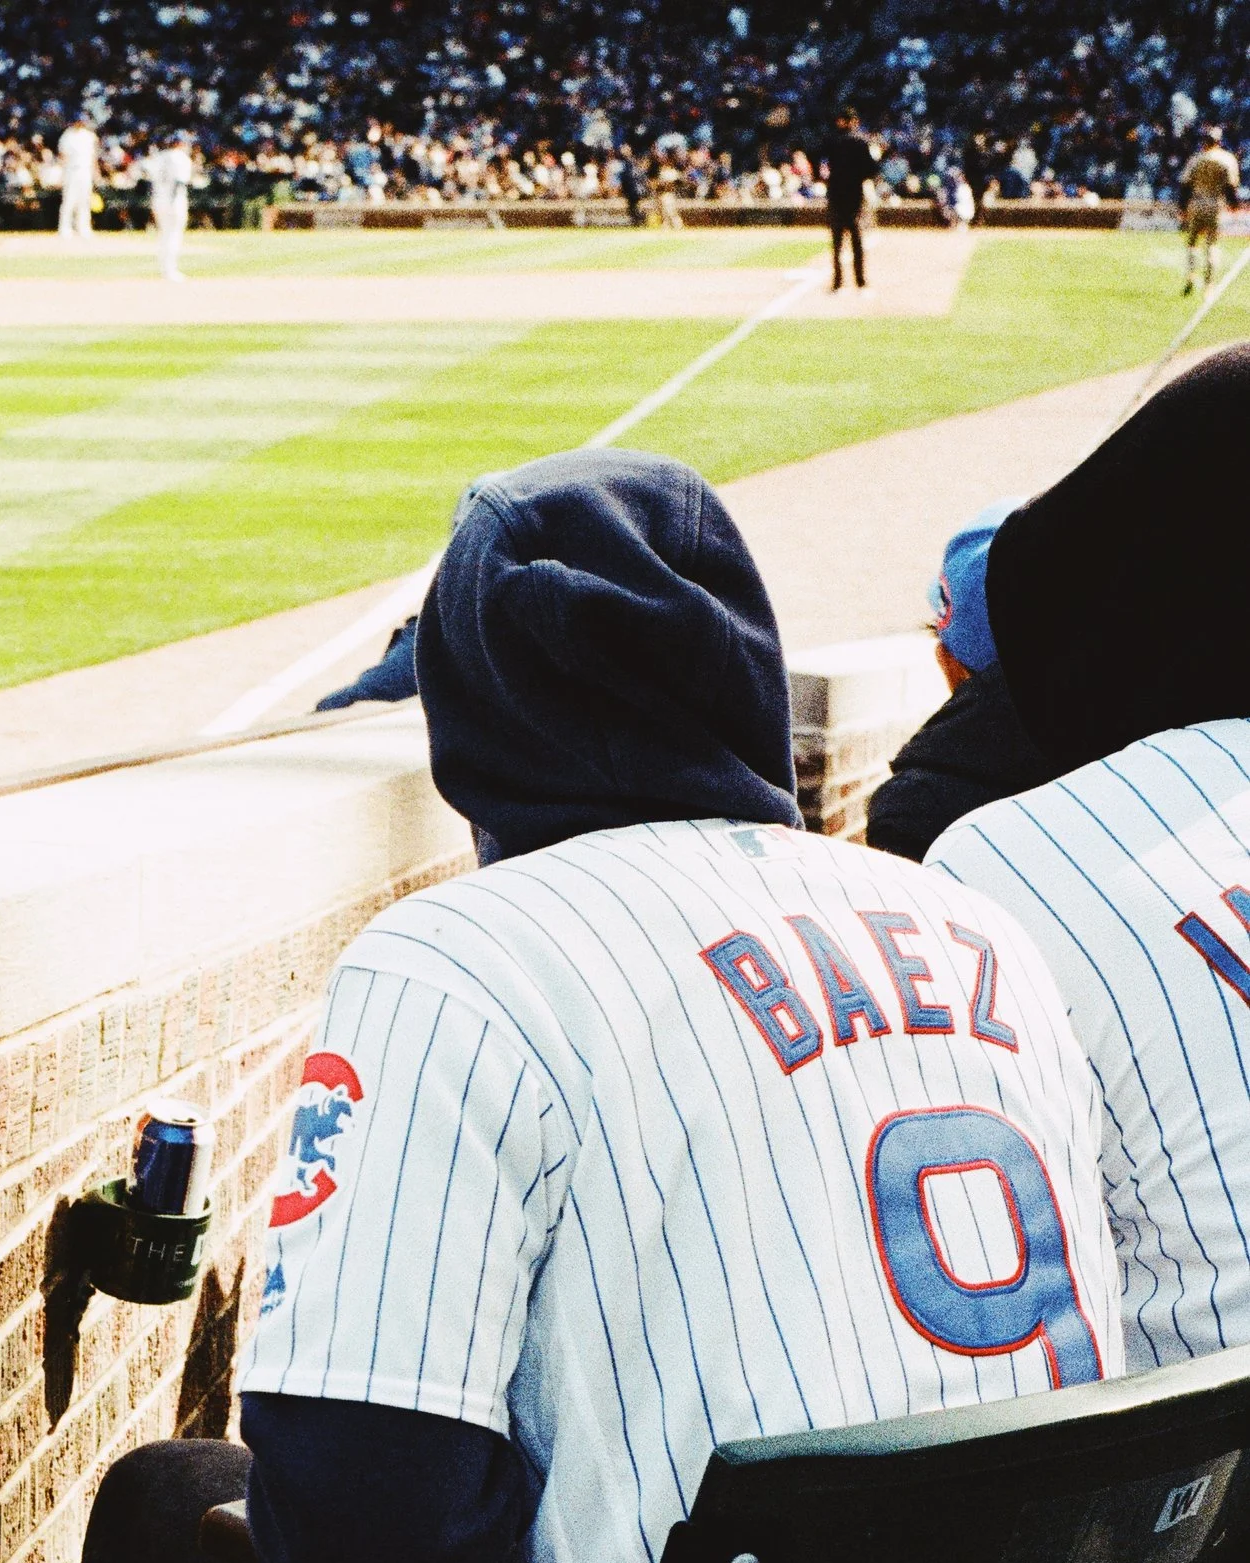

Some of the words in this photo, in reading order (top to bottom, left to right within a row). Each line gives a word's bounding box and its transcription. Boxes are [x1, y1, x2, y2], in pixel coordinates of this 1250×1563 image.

[699, 908, 1020, 1076] BAEZ
[131, 1236, 186, 1263] THE
[1168, 1480, 1205, 1523] W
